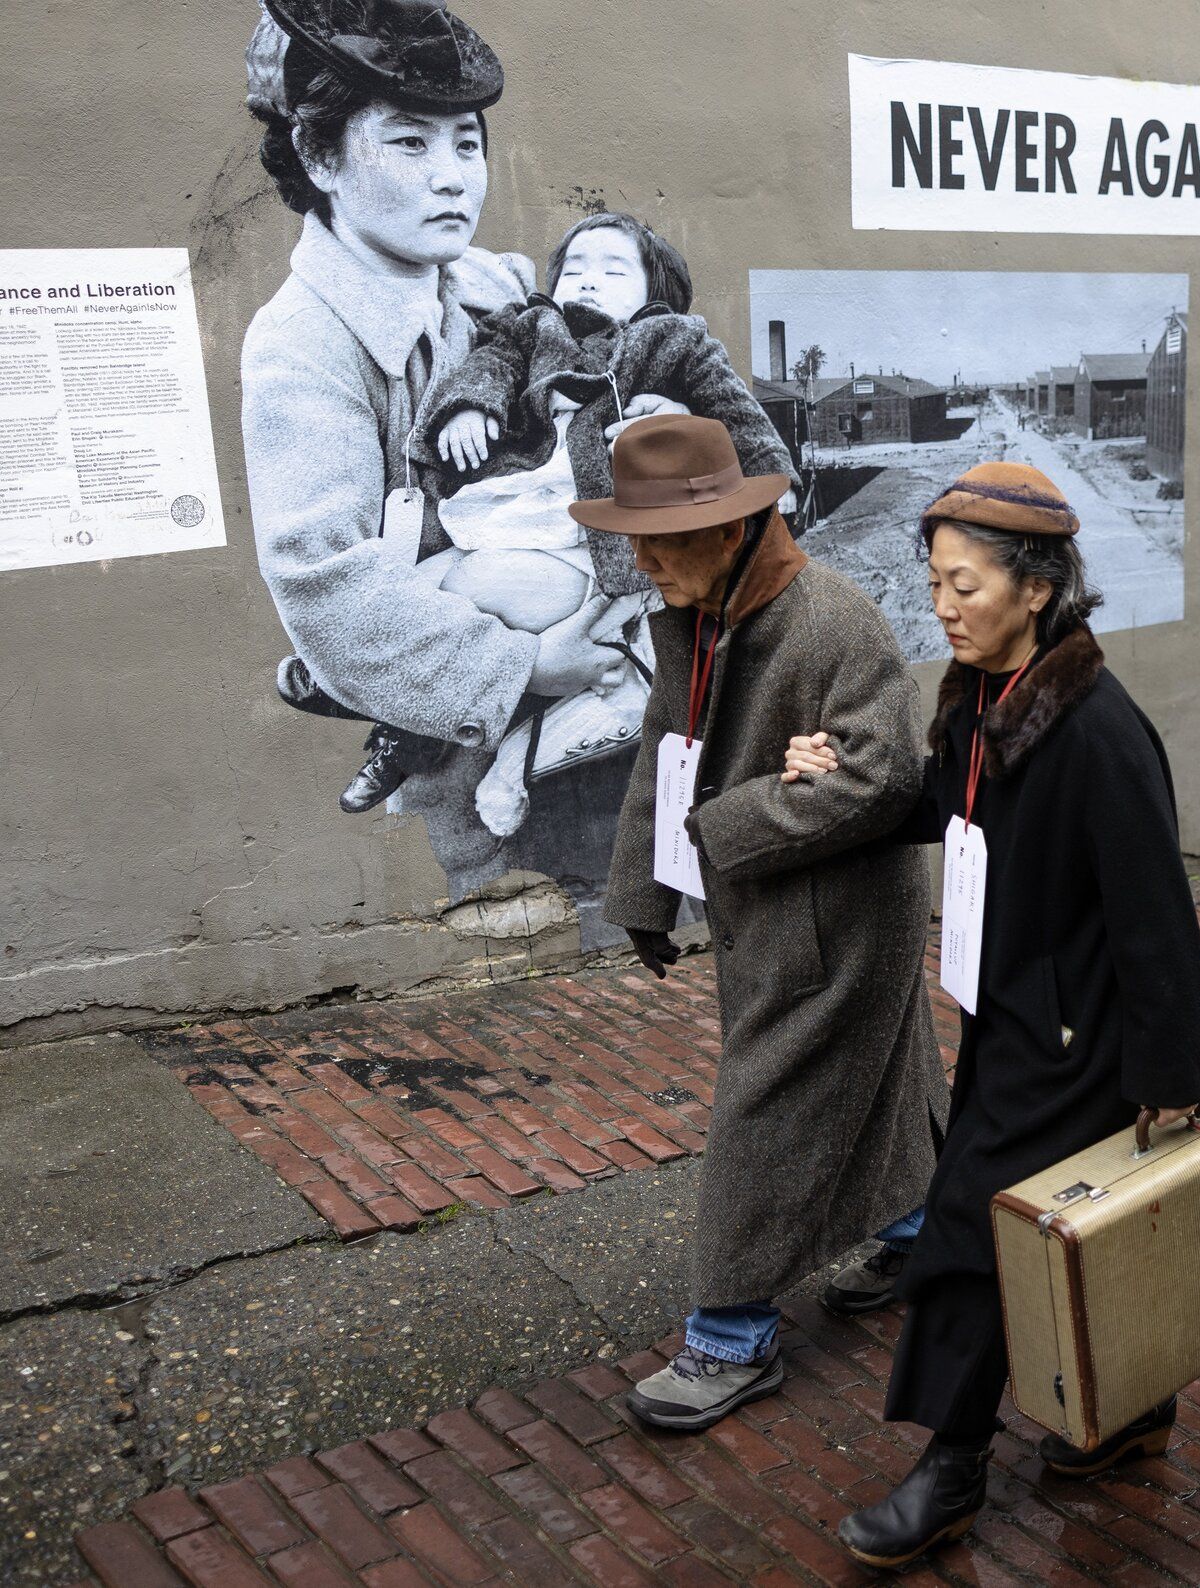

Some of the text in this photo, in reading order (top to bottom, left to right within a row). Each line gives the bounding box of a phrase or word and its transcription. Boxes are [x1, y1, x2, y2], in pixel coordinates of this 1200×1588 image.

[890, 100, 1077, 195] NEVER
[48, 284, 81, 299] and
[87, 282, 176, 298] Liberation
[10, 305, 79, 316] #FreeThemAll
[84, 302, 178, 314] #NeverAgainIsNow
